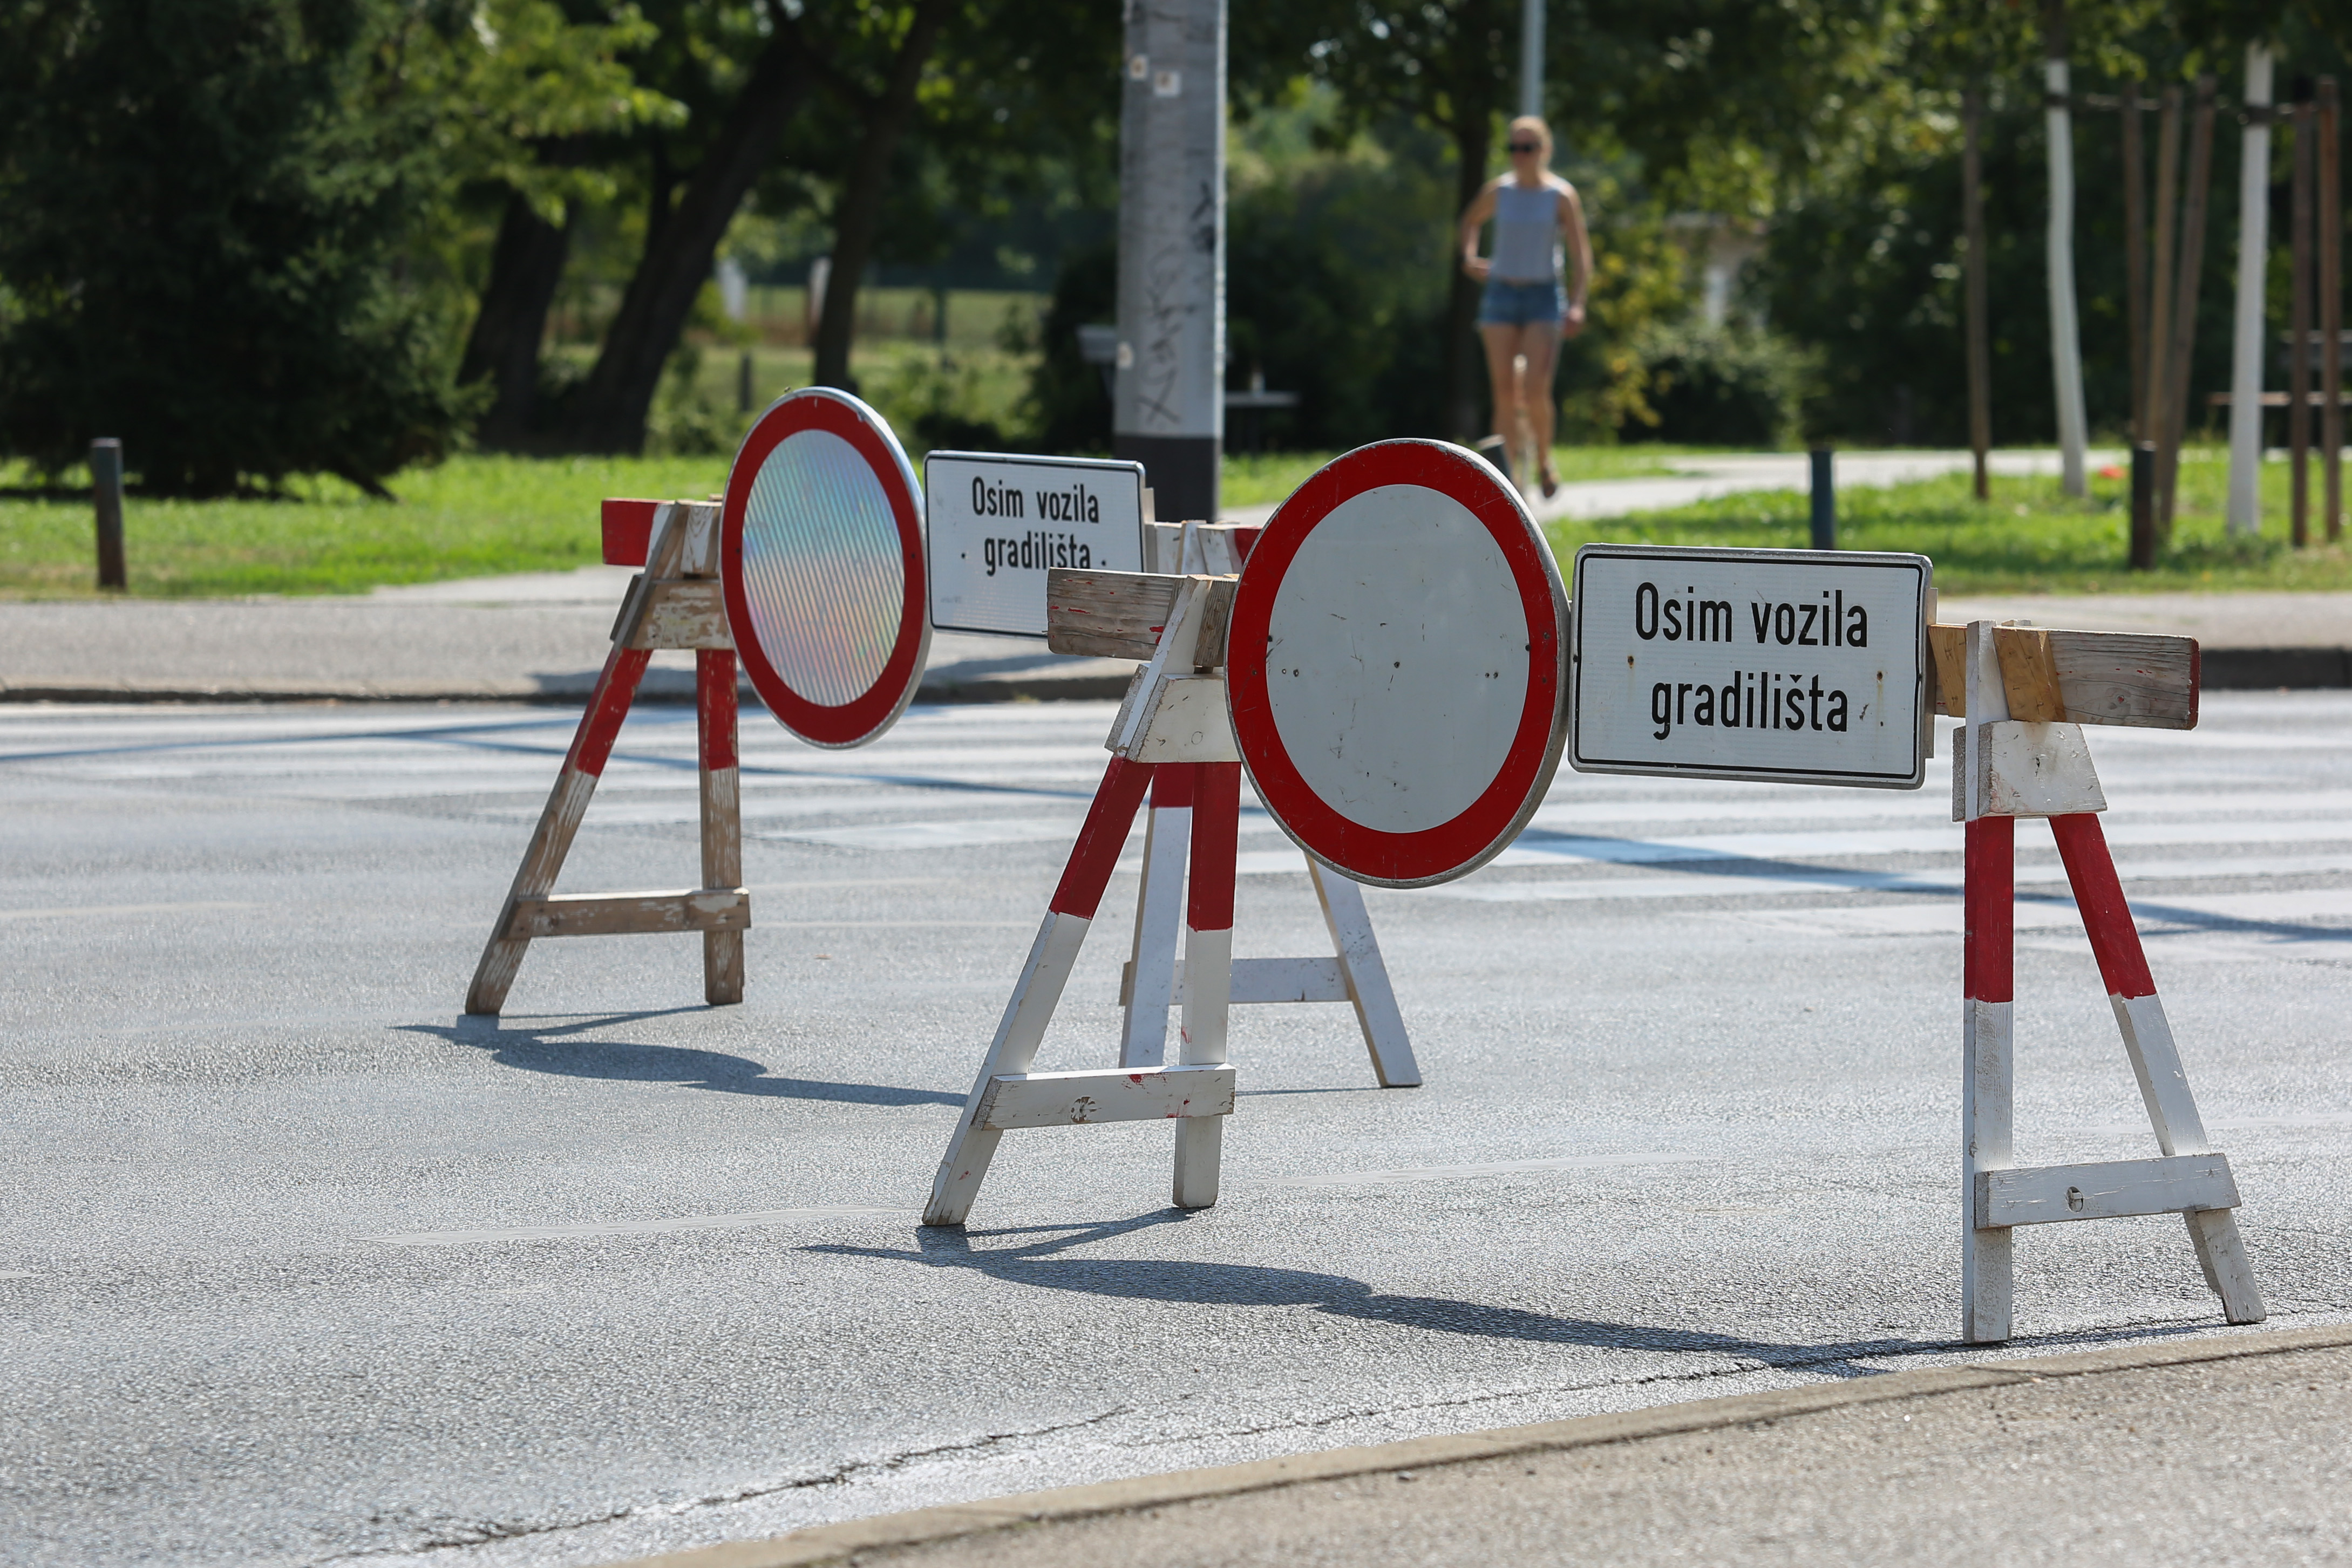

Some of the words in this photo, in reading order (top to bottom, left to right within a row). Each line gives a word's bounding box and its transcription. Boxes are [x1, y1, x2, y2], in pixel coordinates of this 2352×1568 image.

[972, 476, 1024, 518] Osim
[1035, 483, 1099, 524] vozila
[984, 530, 1091, 577] gradilišta
[1635, 582, 1732, 643] Osim
[1750, 589, 1867, 648] vozila
[1651, 670, 1848, 740] gradilišta
